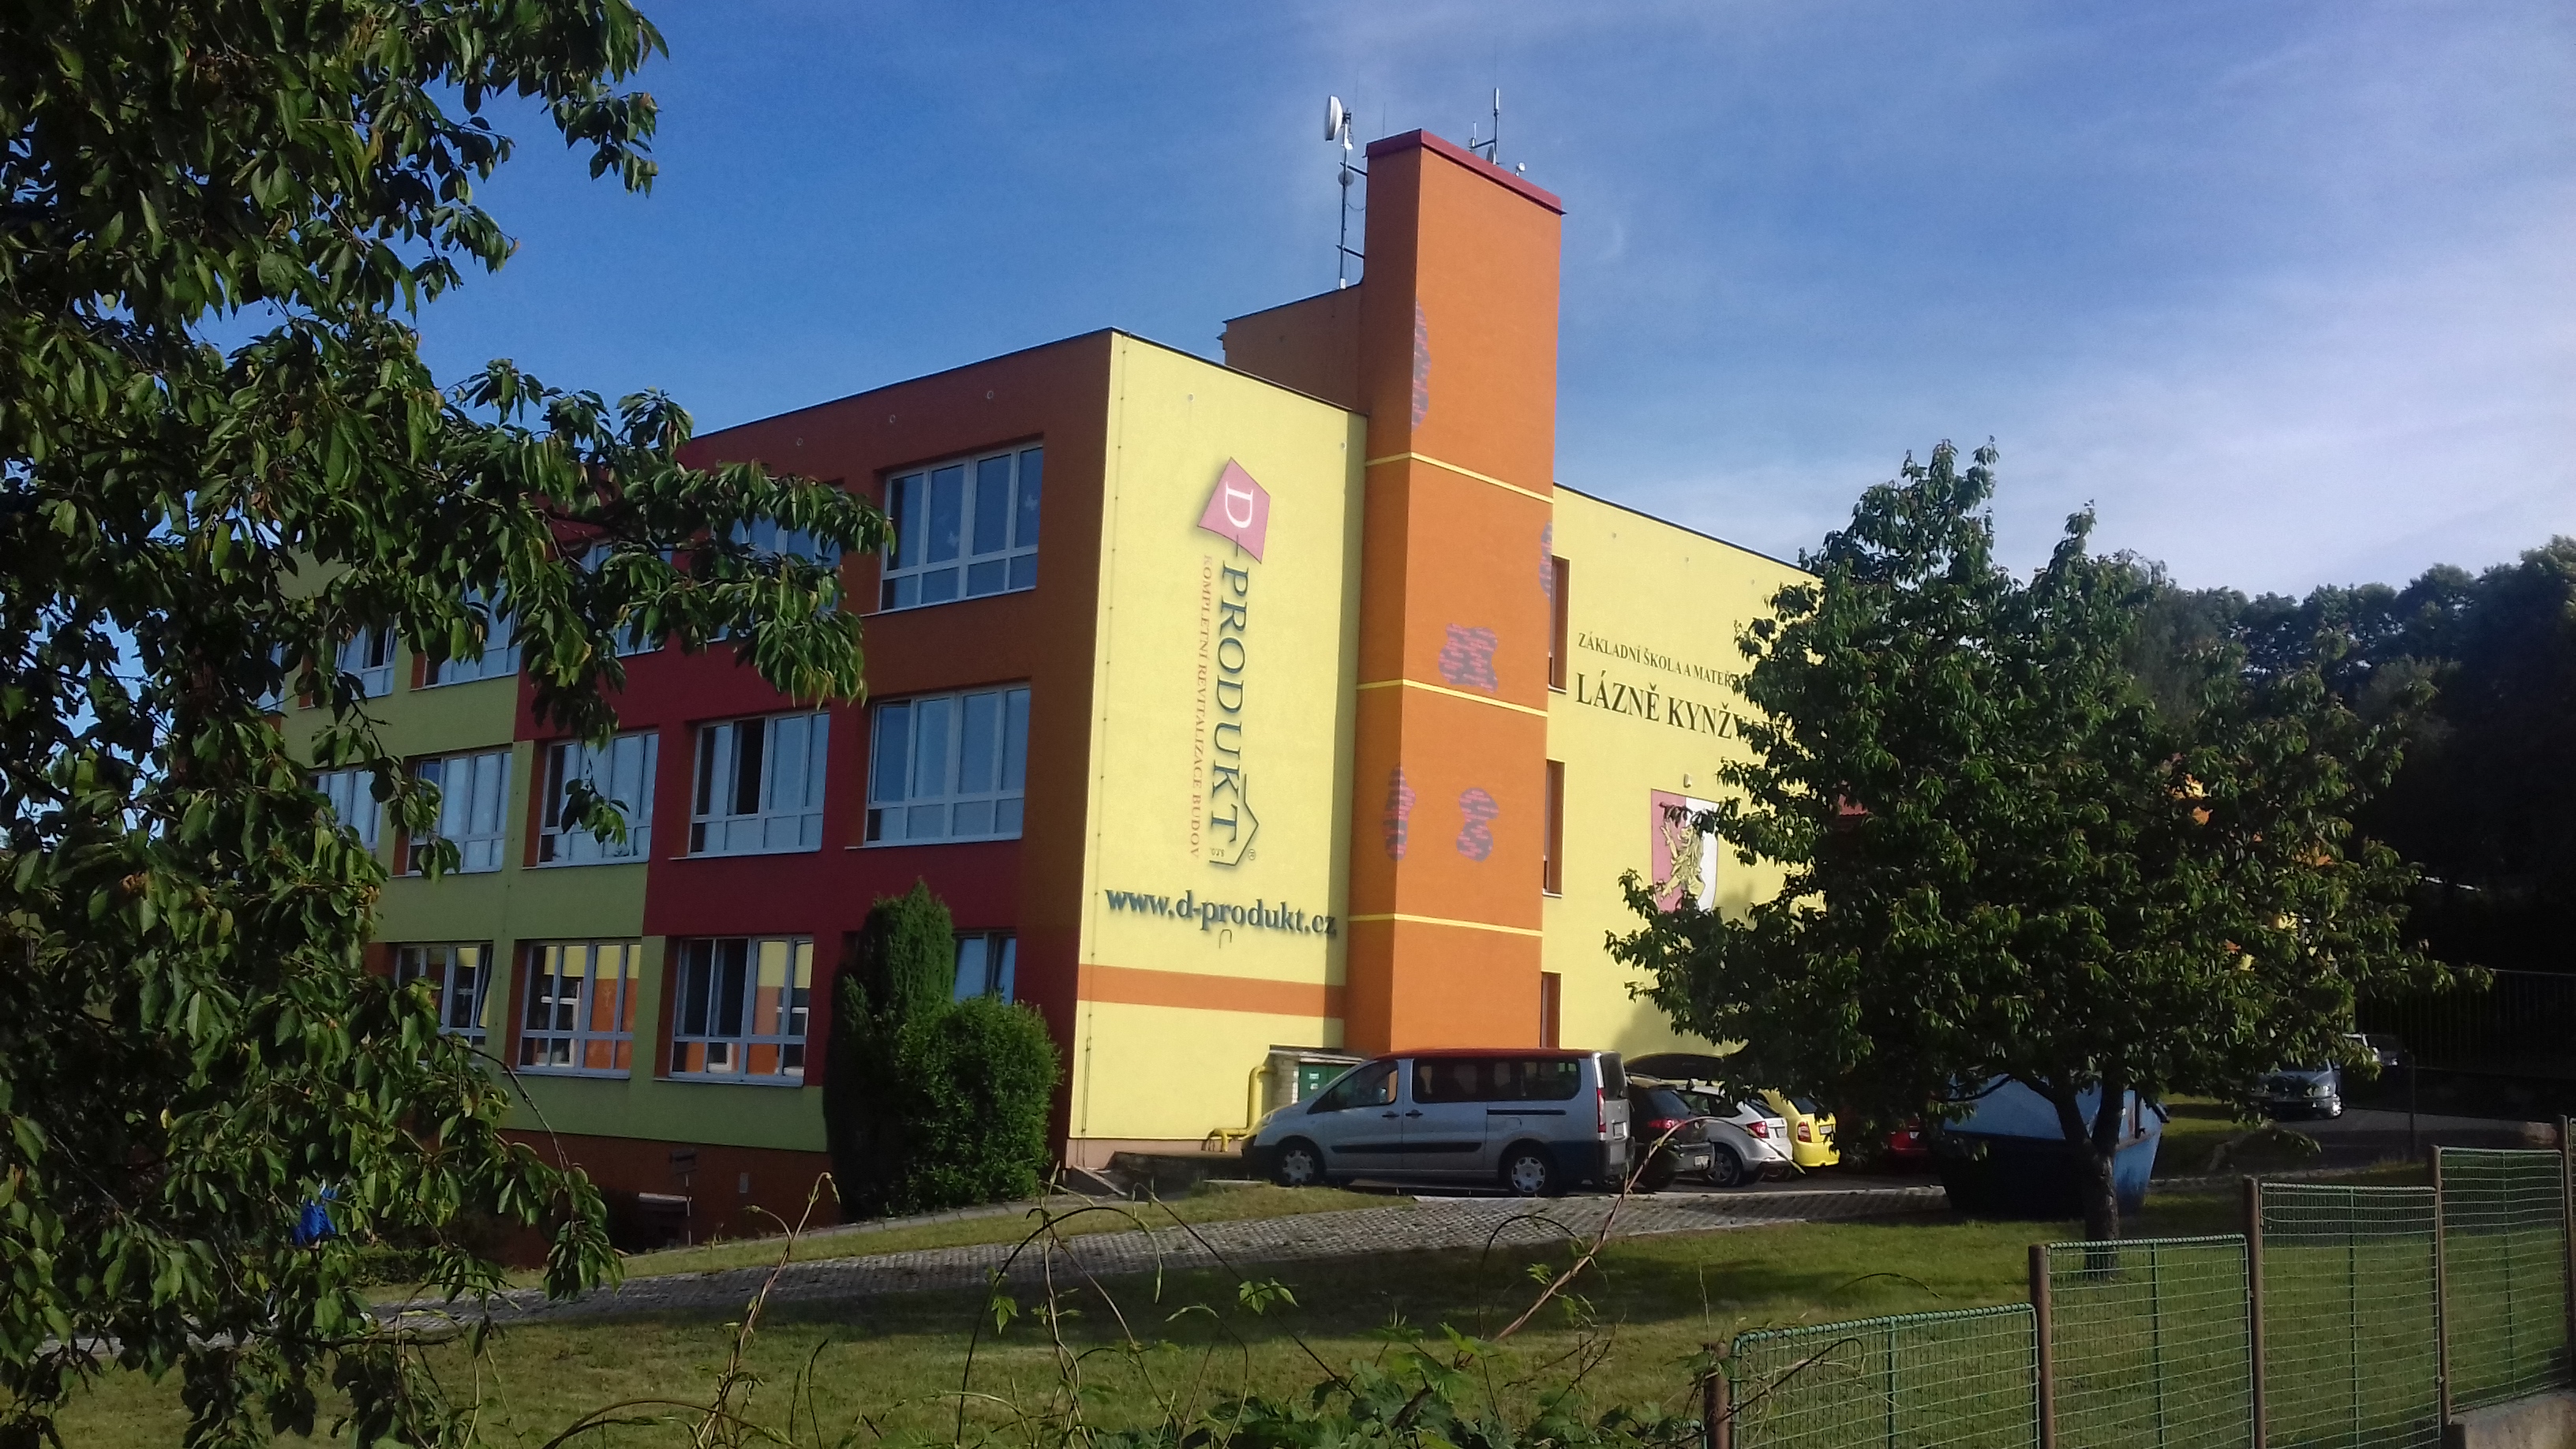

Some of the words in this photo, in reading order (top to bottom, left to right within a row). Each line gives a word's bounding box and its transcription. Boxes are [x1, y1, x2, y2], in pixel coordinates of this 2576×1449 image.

[1578, 631, 1641, 664] ZÁKLADNÍ
[1643, 646, 1682, 675] ŠKOLA
[1683, 662, 1691, 677] A
[1576, 669, 1661, 722] LÁZNĚ
[1193, 664, 1208, 788] REVITALIZACE
[1190, 793, 1202, 859] BUDOV
[1105, 889, 1338, 936] www.d-produkt.cz
